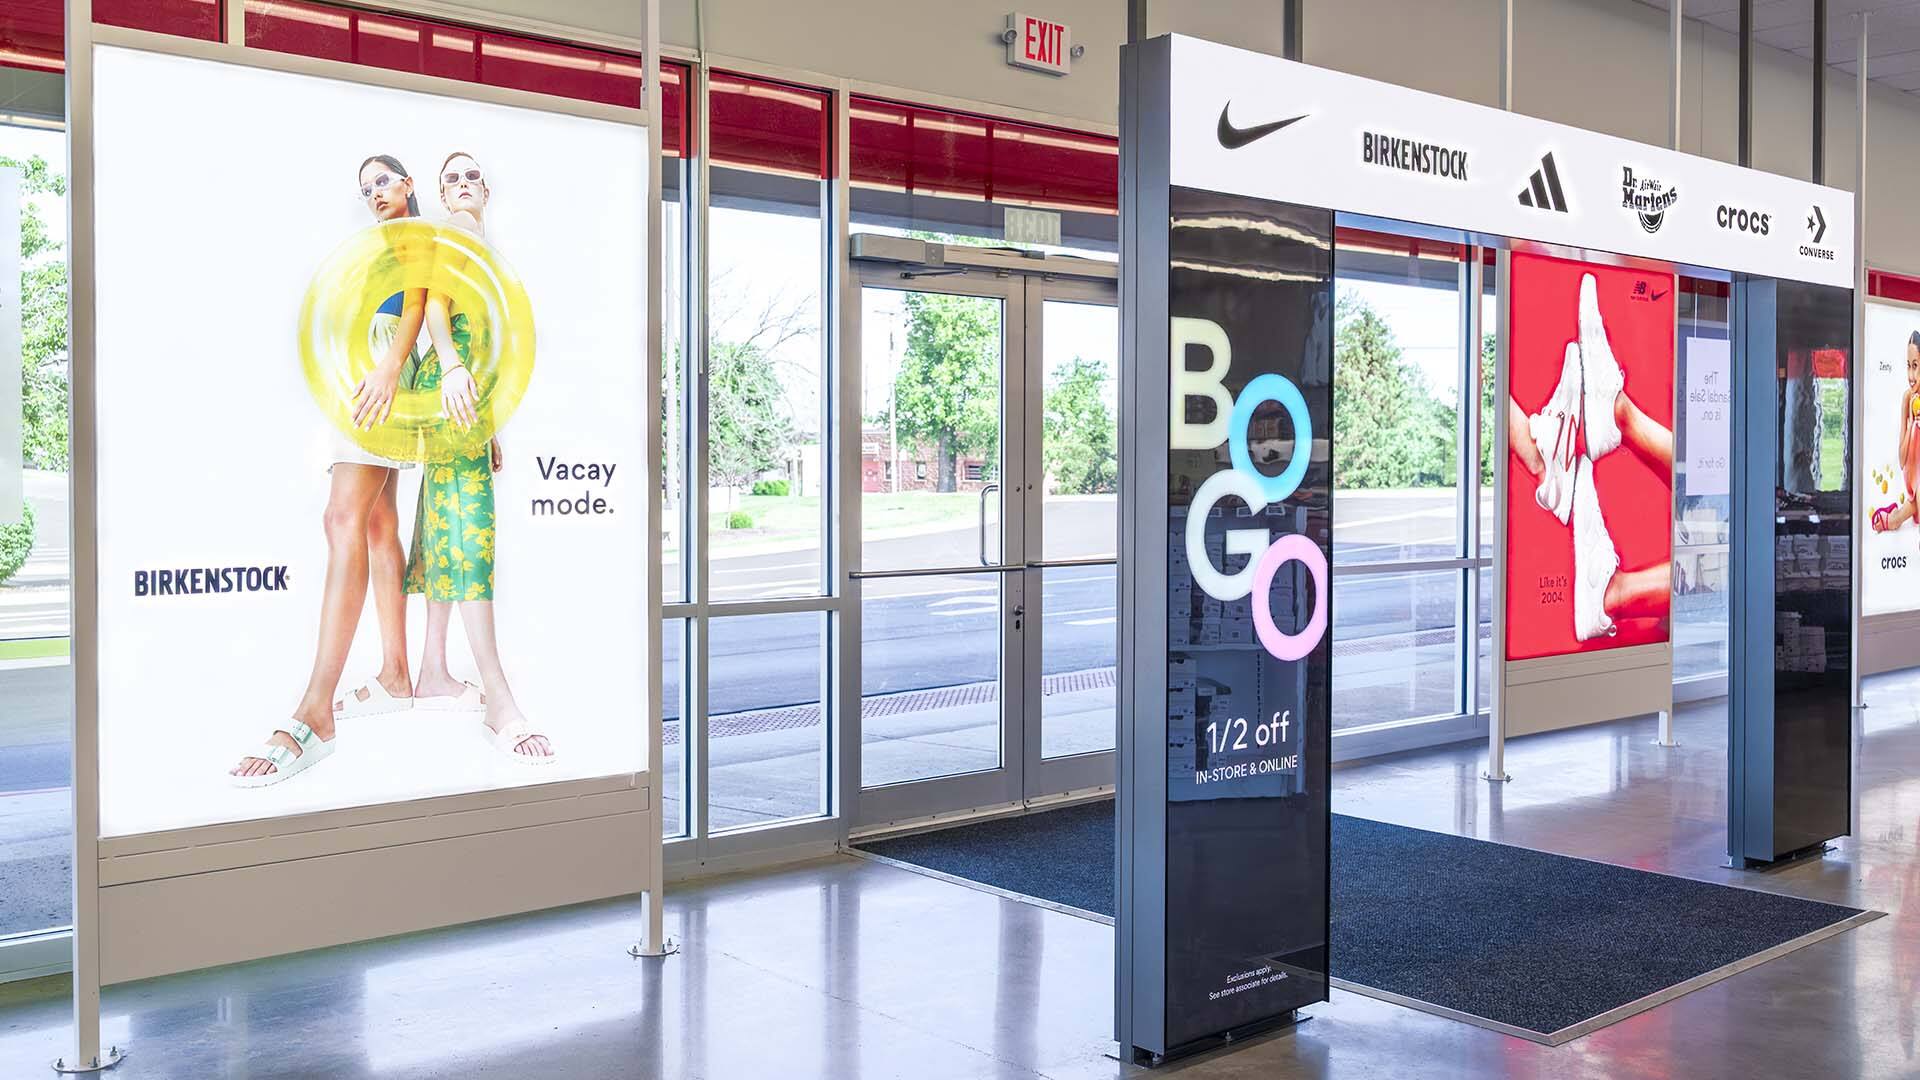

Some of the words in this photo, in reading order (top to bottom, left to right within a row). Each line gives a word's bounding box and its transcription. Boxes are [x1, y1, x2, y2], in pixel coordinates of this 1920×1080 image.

[1026, 17, 1064, 66] EXIT
[1363, 131, 1468, 181] BIRKENSTOCK
[1622, 187, 1678, 212] Martens
[1717, 205, 1769, 236] crocs
[1799, 245, 1834, 261] CONVERSE
[536, 456, 617, 488] Vacay
[531, 490, 614, 516] mode.
[1881, 555, 1907, 570] crocs
[134, 565, 289, 597] BIRKENSTOCK
[1539, 575, 1555, 589] Like
[1556, 575, 1568, 588] it's
[1541, 591, 1565, 604] 2004.
[1206, 717, 1248, 753] 1/2
[1255, 710, 1290, 746] off
[1196, 763, 1247, 785] IN-STORE
[1249, 762, 1257, 776] &
[1259, 754, 1298, 774] ONLINE
[1209, 991, 1220, 1000] See
[1221, 986, 1235, 997] store
[1235, 980, 1260, 993] associate
[1261, 977, 1269, 985] for
[1226, 970, 1255, 984] Exclusions
